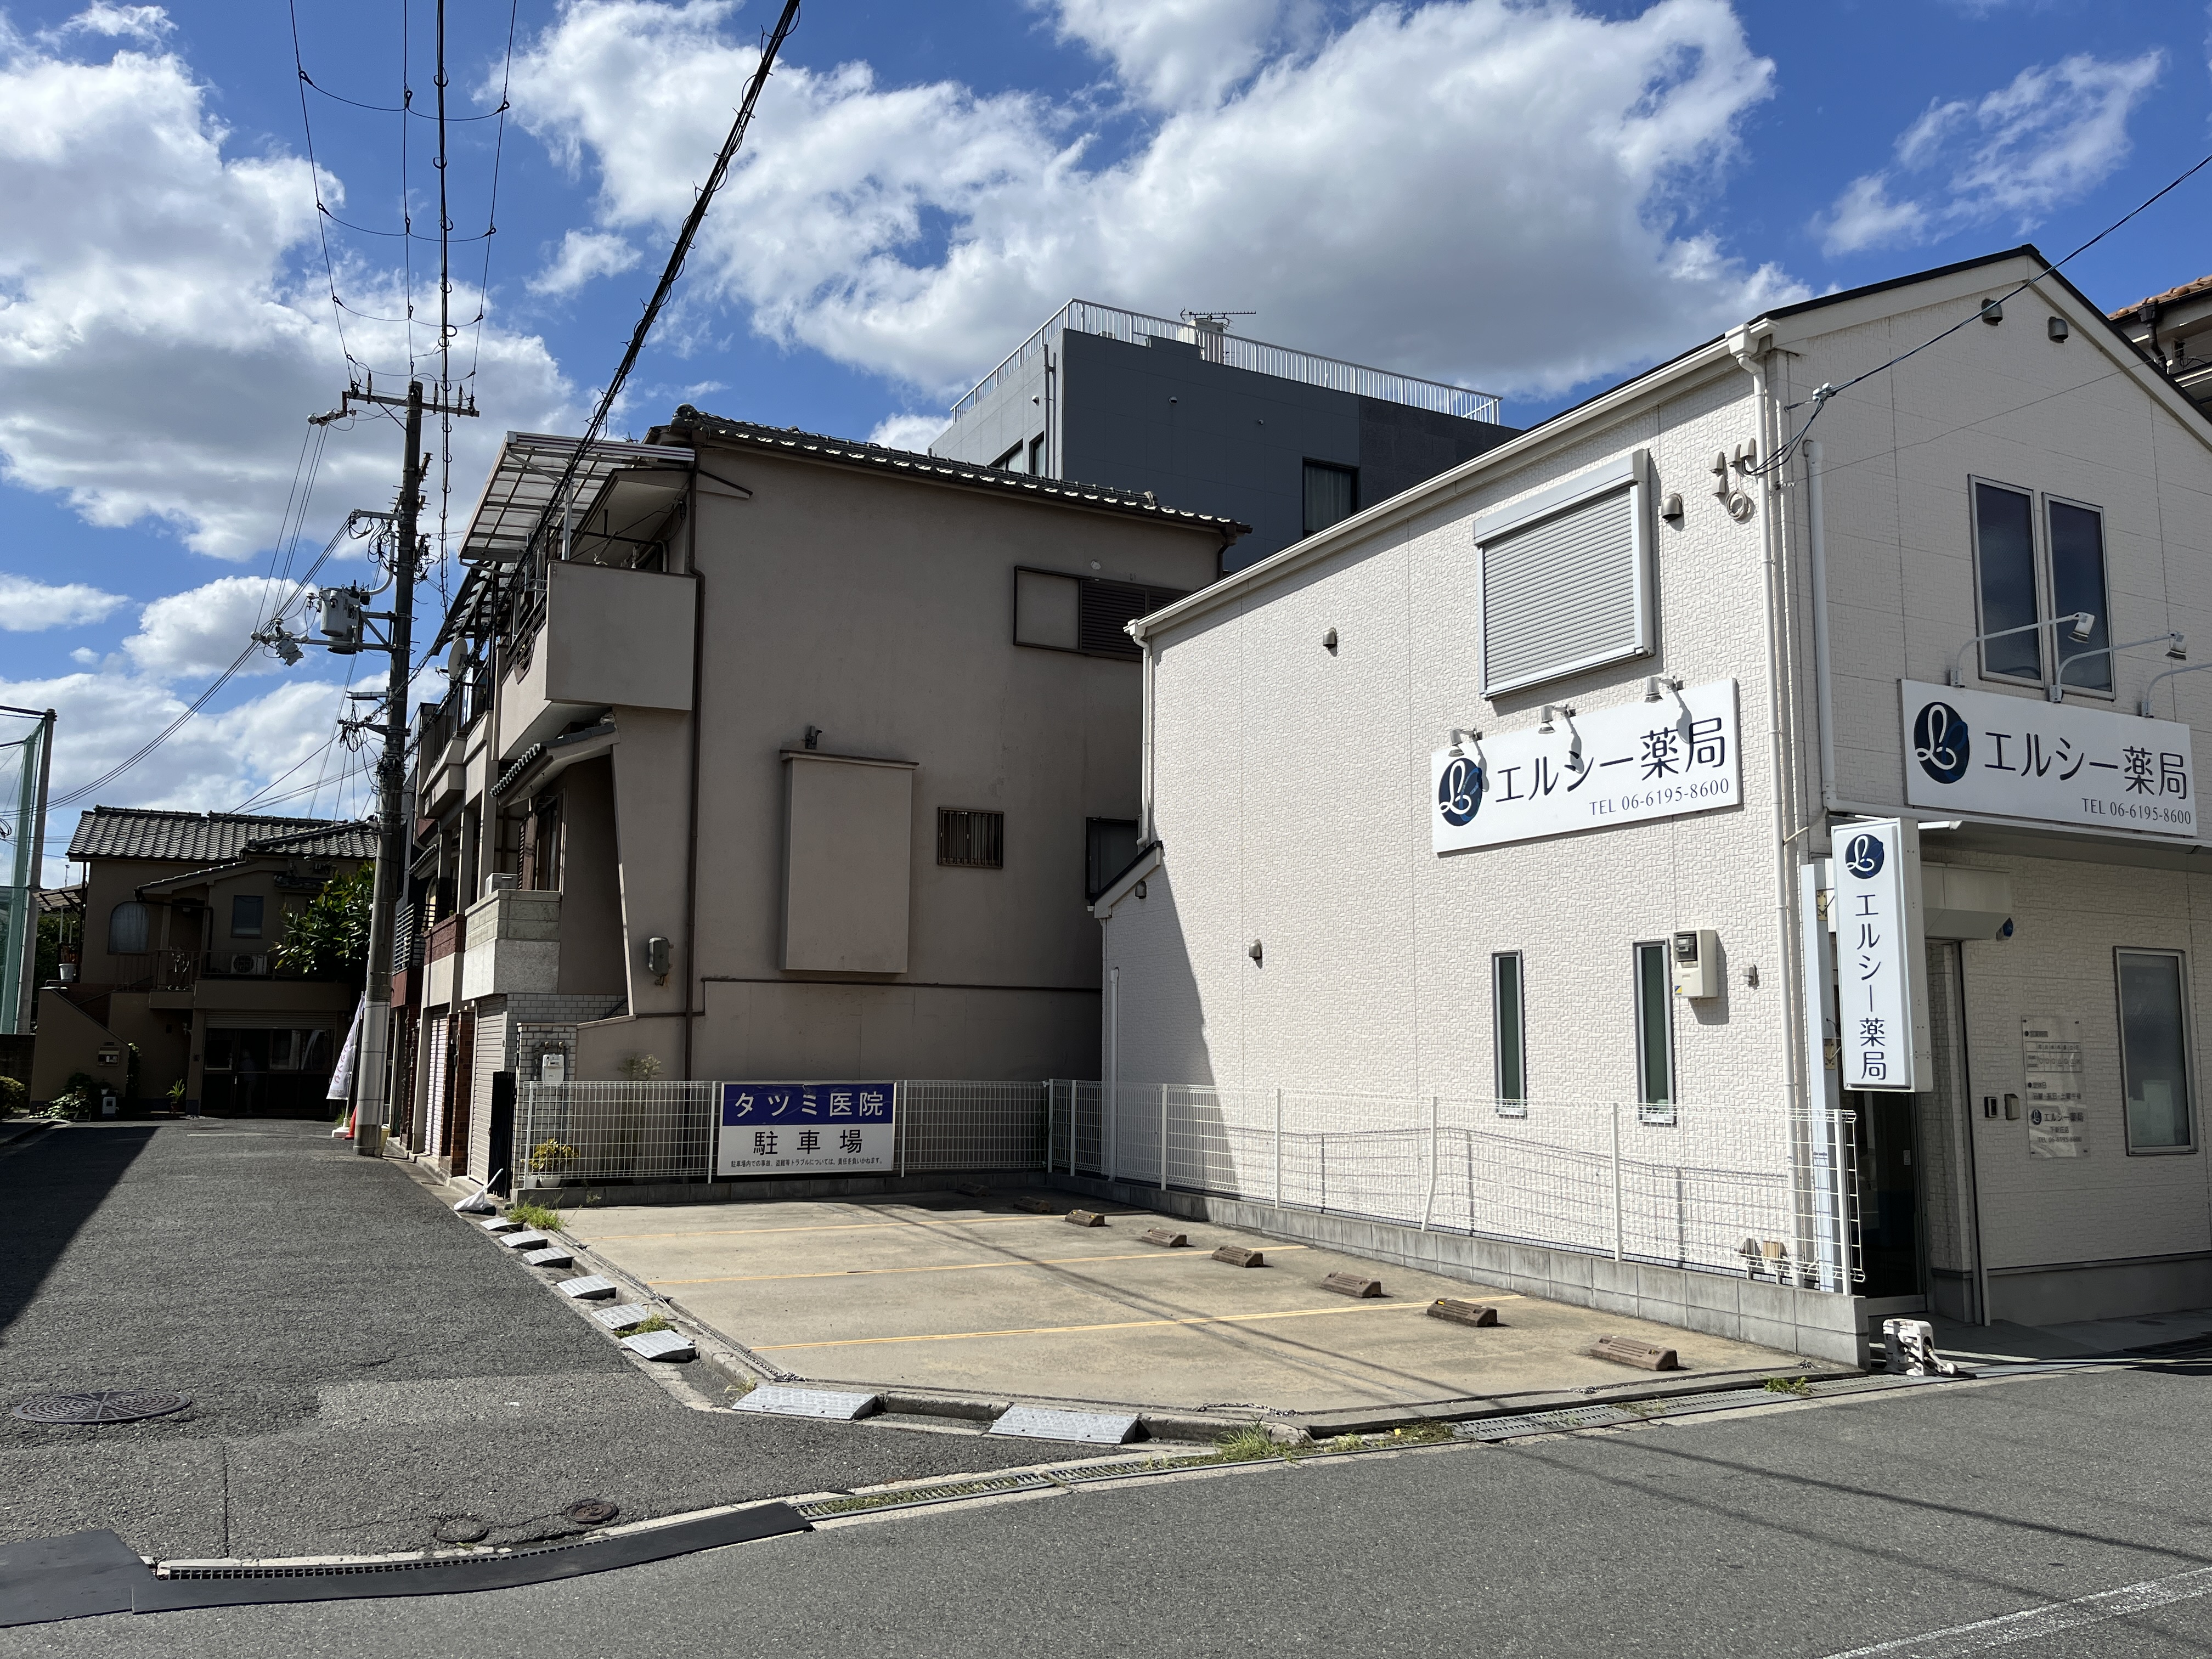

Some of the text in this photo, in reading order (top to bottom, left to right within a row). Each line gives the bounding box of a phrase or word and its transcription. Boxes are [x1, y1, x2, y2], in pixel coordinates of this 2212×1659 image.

[1495, 716, 1725, 803] エルシー薬局
[1984, 731, 2187, 800] エルシー薬局
[1589, 777, 1729, 816] TEL 06-6195-8600
[2081, 798, 2192, 825] TEL 06-6195-8600
[1855, 894, 1887, 1081] エルシー薬局
[735, 1091, 883, 1118] タツミ医院
[753, 1129, 863, 1156] 駐車場
